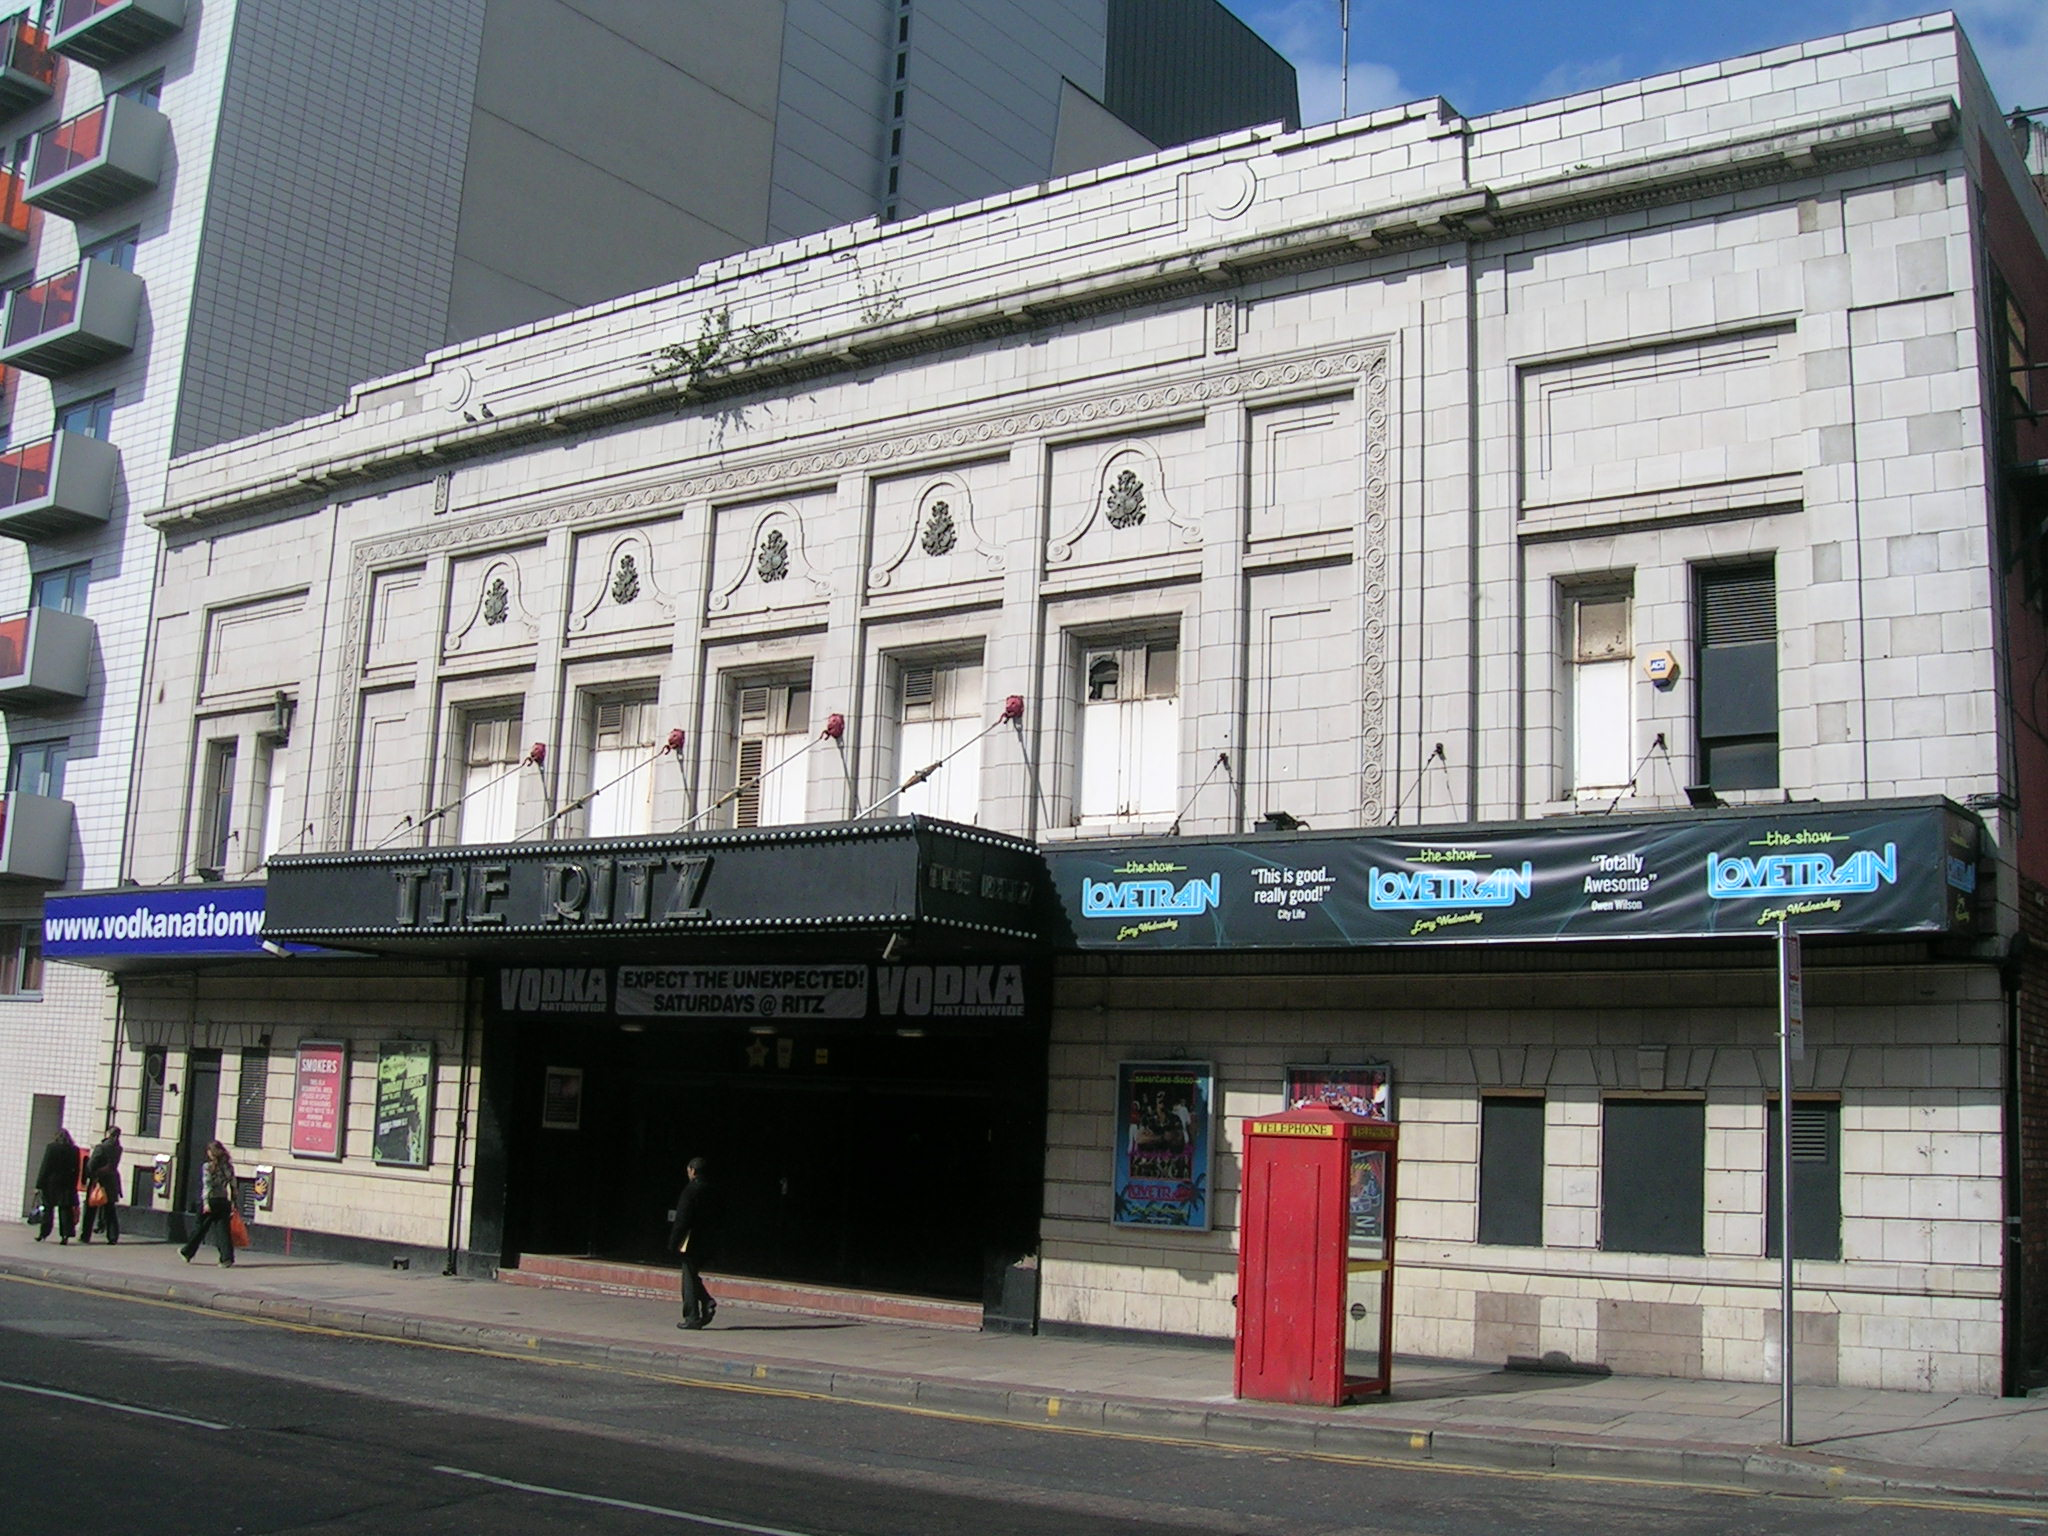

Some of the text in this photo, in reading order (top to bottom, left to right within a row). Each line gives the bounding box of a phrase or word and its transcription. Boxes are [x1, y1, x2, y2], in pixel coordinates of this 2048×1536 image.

[1766, 831, 1831, 846] the show
[1421, 848, 1477, 863] the show
[1126, 860, 1174, 874] the show
[1707, 842, 1897, 899] LOVETRAIN
[1283, 869, 1294, 883] is
[1296, 868, 1336, 887] good...
[1368, 861, 1532, 910] LOVETRAIN
[393, 864, 510, 925] THE
[1082, 872, 1220, 918] LOVETRAIN
[1254, 888, 1287, 906] really
[1614, 898, 1643, 910] Wilson
[1757, 898, 1841, 925] Every Wednesday
[1277, 908, 1306, 921] City Life
[1411, 911, 1482, 935] Every Wednesday
[1138, 918, 1178, 932] Wednesday
[623, 970, 865, 989] EXPECT THE UNEXPECTED!
[500, 968, 607, 1012] VODKA
[877, 964, 1024, 1016] VODKA
[540, 1002, 607, 1013] NATIONWIDE
[654, 994, 826, 1016] SATURDAYS @ RITZ
[933, 1005, 1024, 1017] NATIONWIDE
[301, 1058, 338, 1074] SMOKERS
[1259, 1123, 1327, 1135] TELEPHONE
